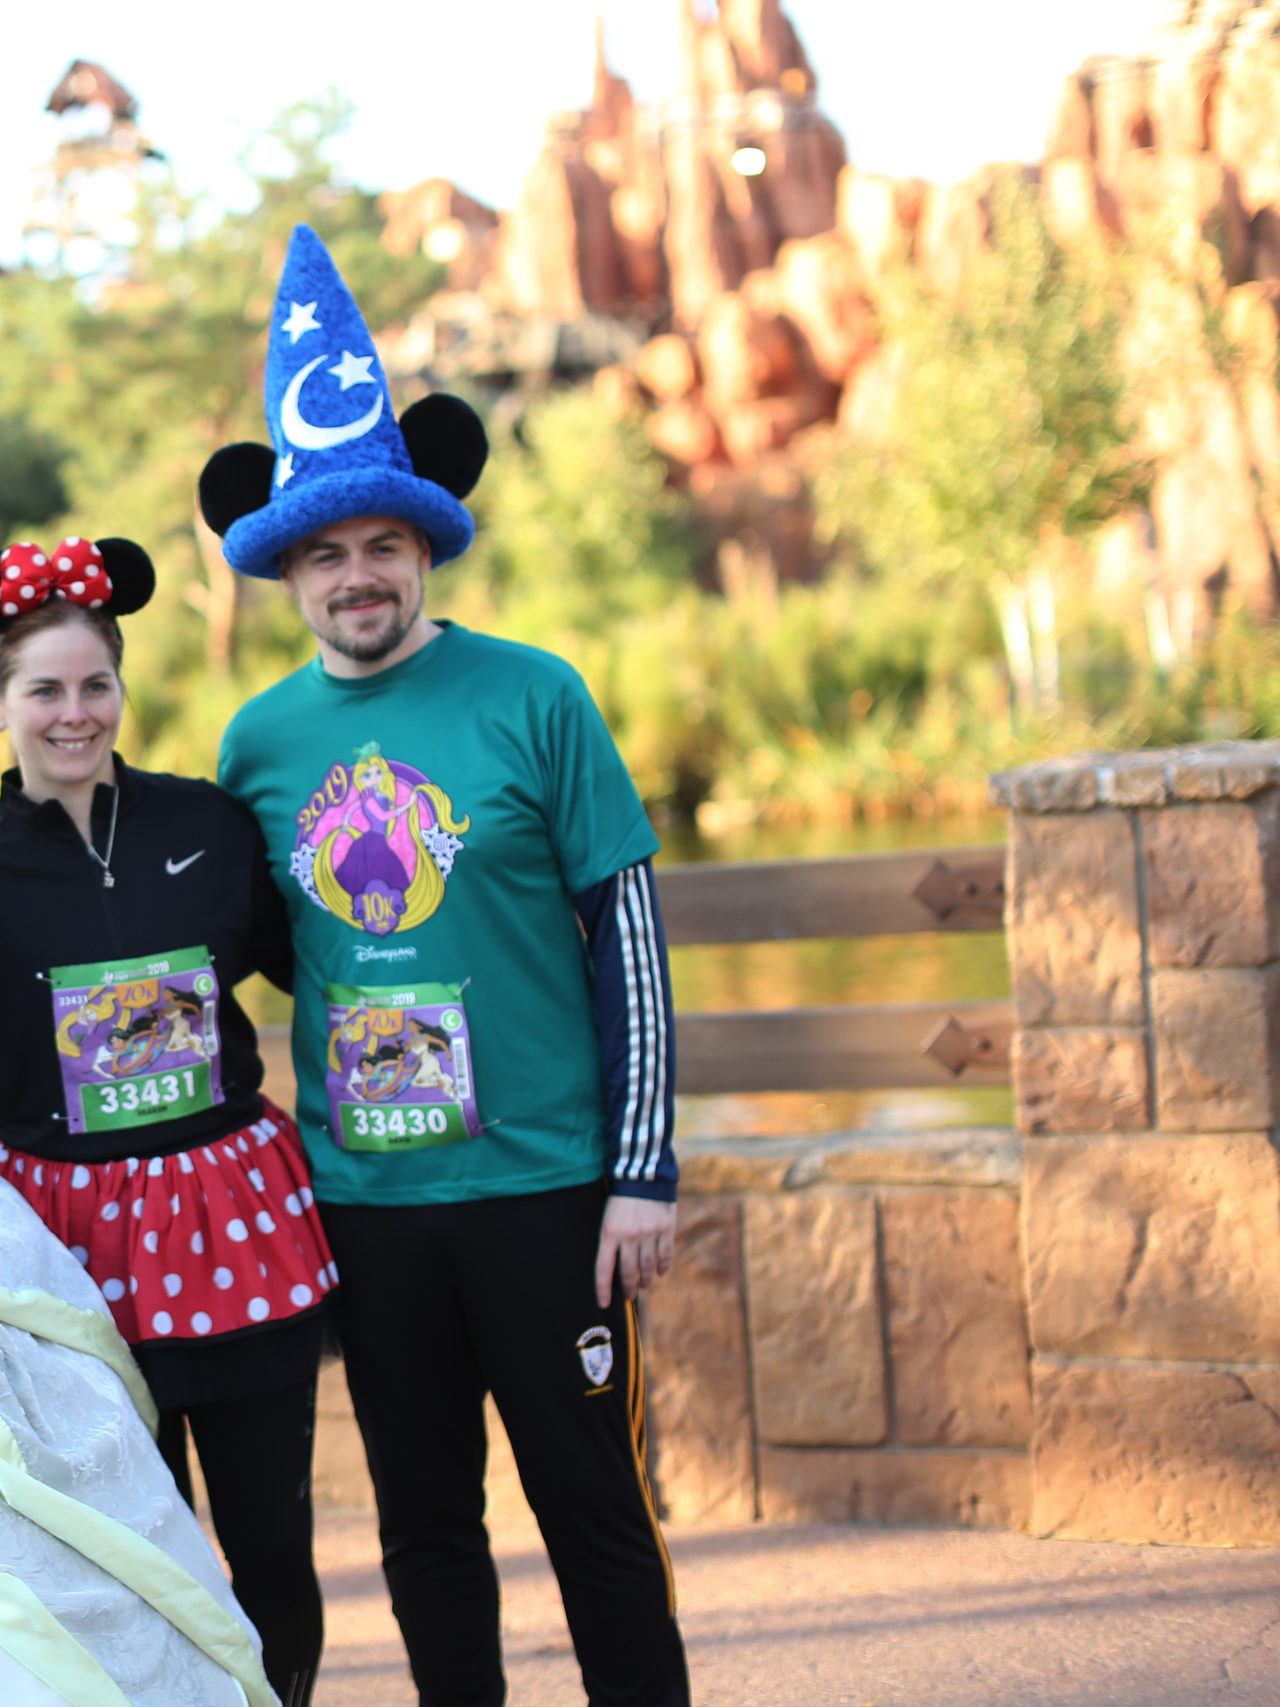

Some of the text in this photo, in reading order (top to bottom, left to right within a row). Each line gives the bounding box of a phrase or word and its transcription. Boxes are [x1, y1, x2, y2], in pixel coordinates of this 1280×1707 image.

[299, 765, 348, 836] 2019
[362, 892, 396, 922] 10K
[147, 960, 170, 976] 2019
[59, 994, 88, 1006] 33431
[123, 983, 155, 1003] 10K
[392, 992, 416, 1005] 2019
[99, 1070, 195, 1114] 33431
[352, 1107, 448, 1137] 33430
